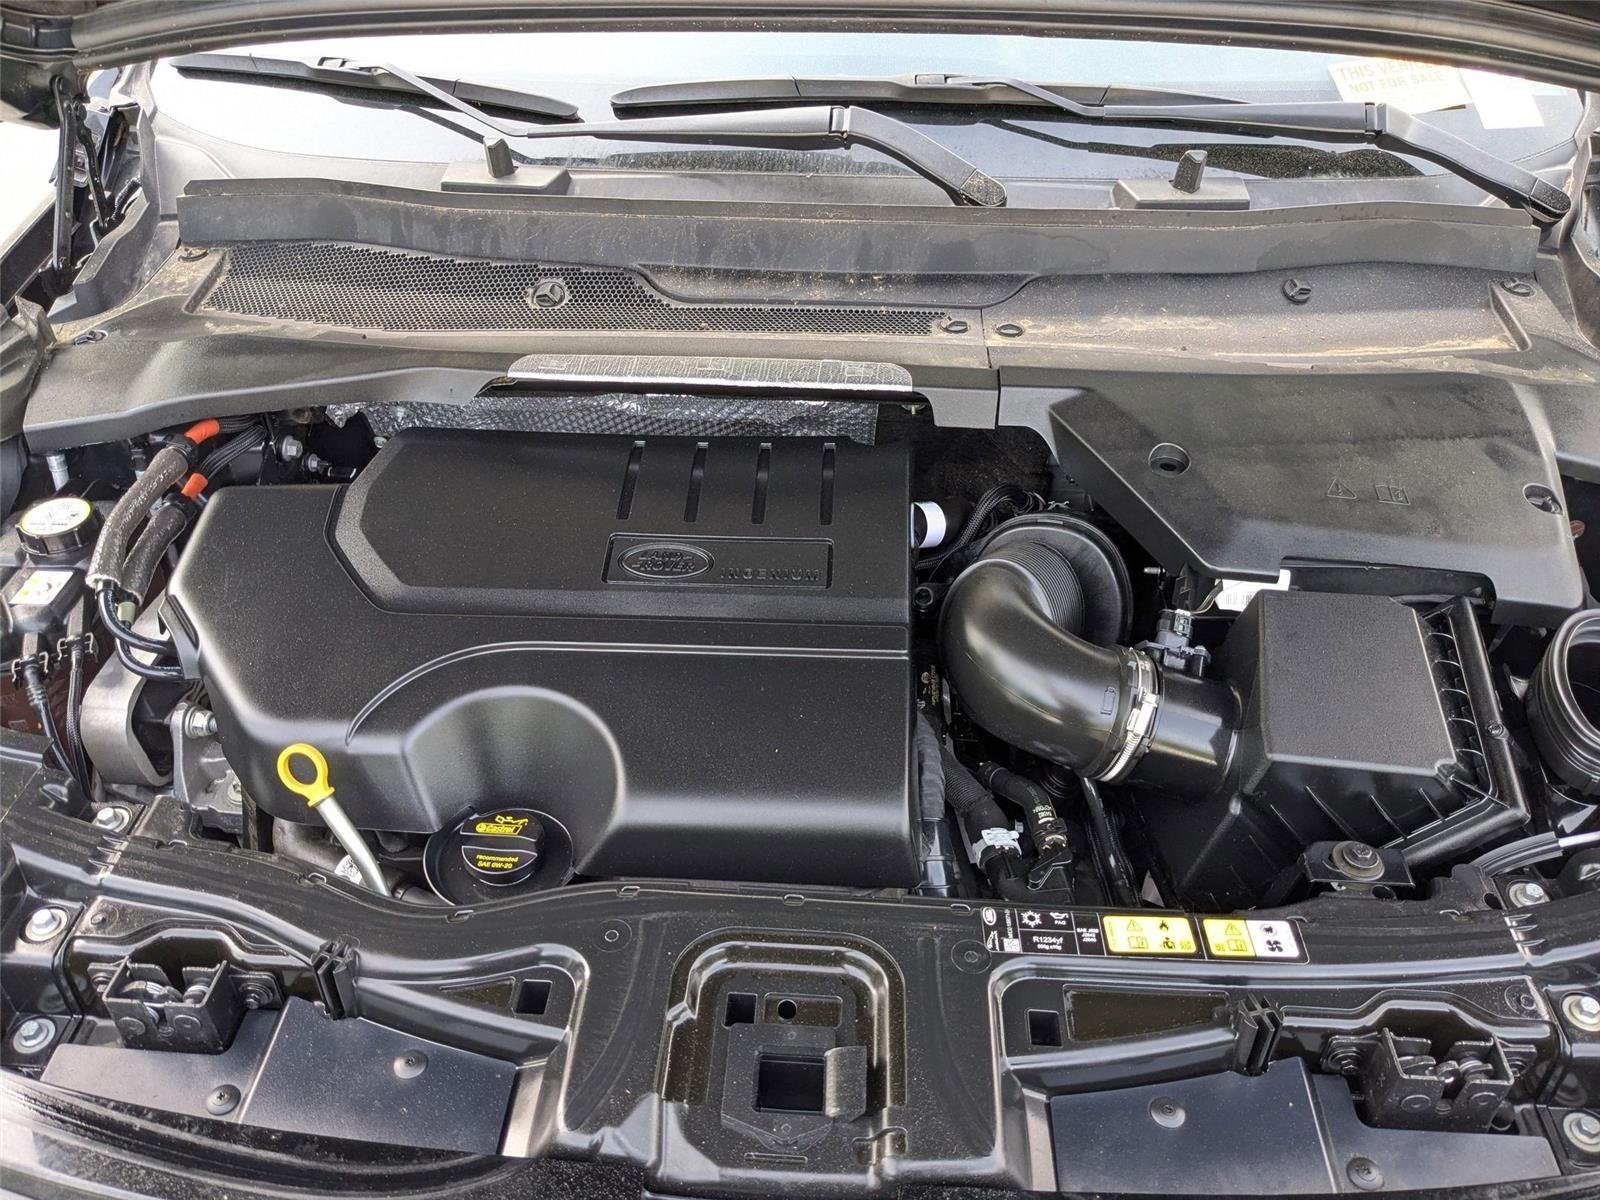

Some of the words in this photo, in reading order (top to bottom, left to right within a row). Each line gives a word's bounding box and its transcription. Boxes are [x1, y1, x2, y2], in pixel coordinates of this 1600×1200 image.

[1337, 64, 1375, 80] THIS
[1376, 60, 1434, 74] VEHIC
[1348, 80, 1376, 94] NOT
[1379, 76, 1408, 89] FOR
[1410, 71, 1446, 85] SALE
[719, 566, 823, 582] INGENIUM
[476, 854, 519, 863] recommended
[1032, 935, 1064, 945] R1234yf
